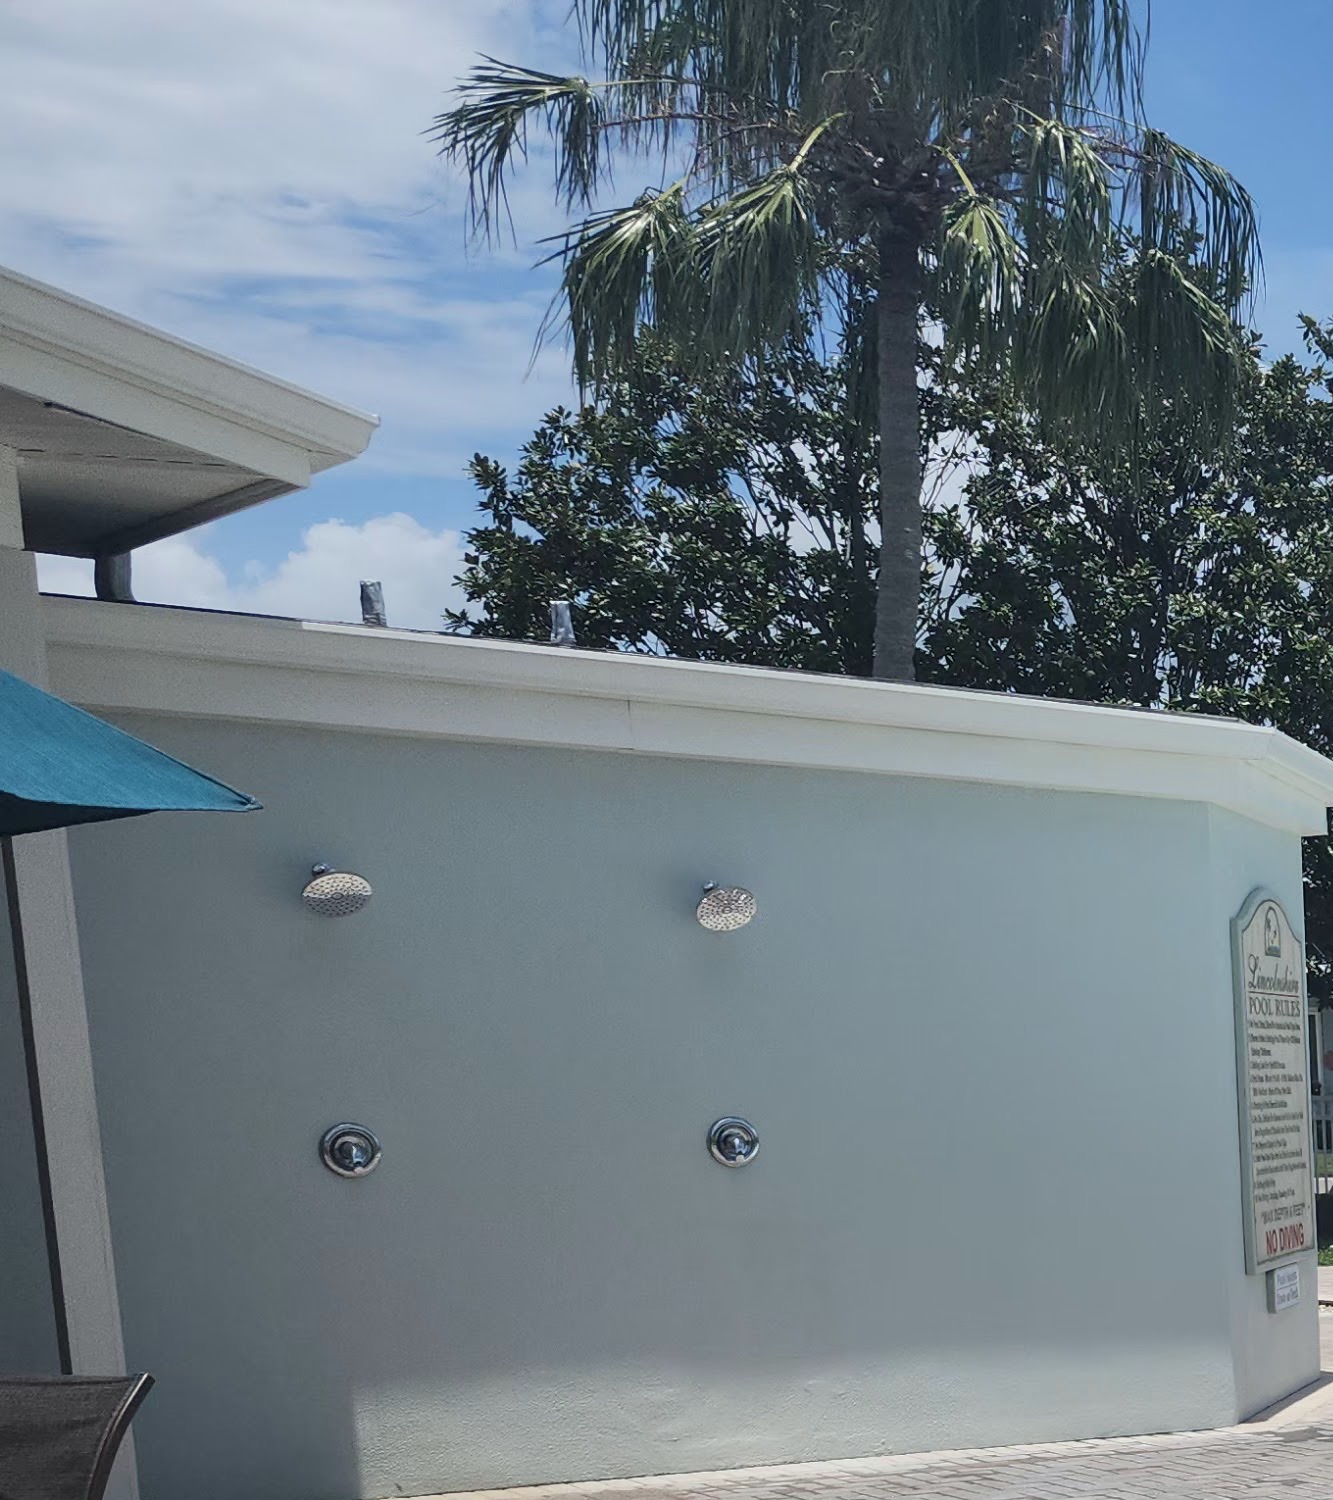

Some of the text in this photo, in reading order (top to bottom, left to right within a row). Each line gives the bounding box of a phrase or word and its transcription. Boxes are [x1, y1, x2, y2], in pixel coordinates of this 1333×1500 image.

[1249, 996, 1300, 1017] POOL RULES
[1265, 1223, 1304, 1256] NO DIVING
